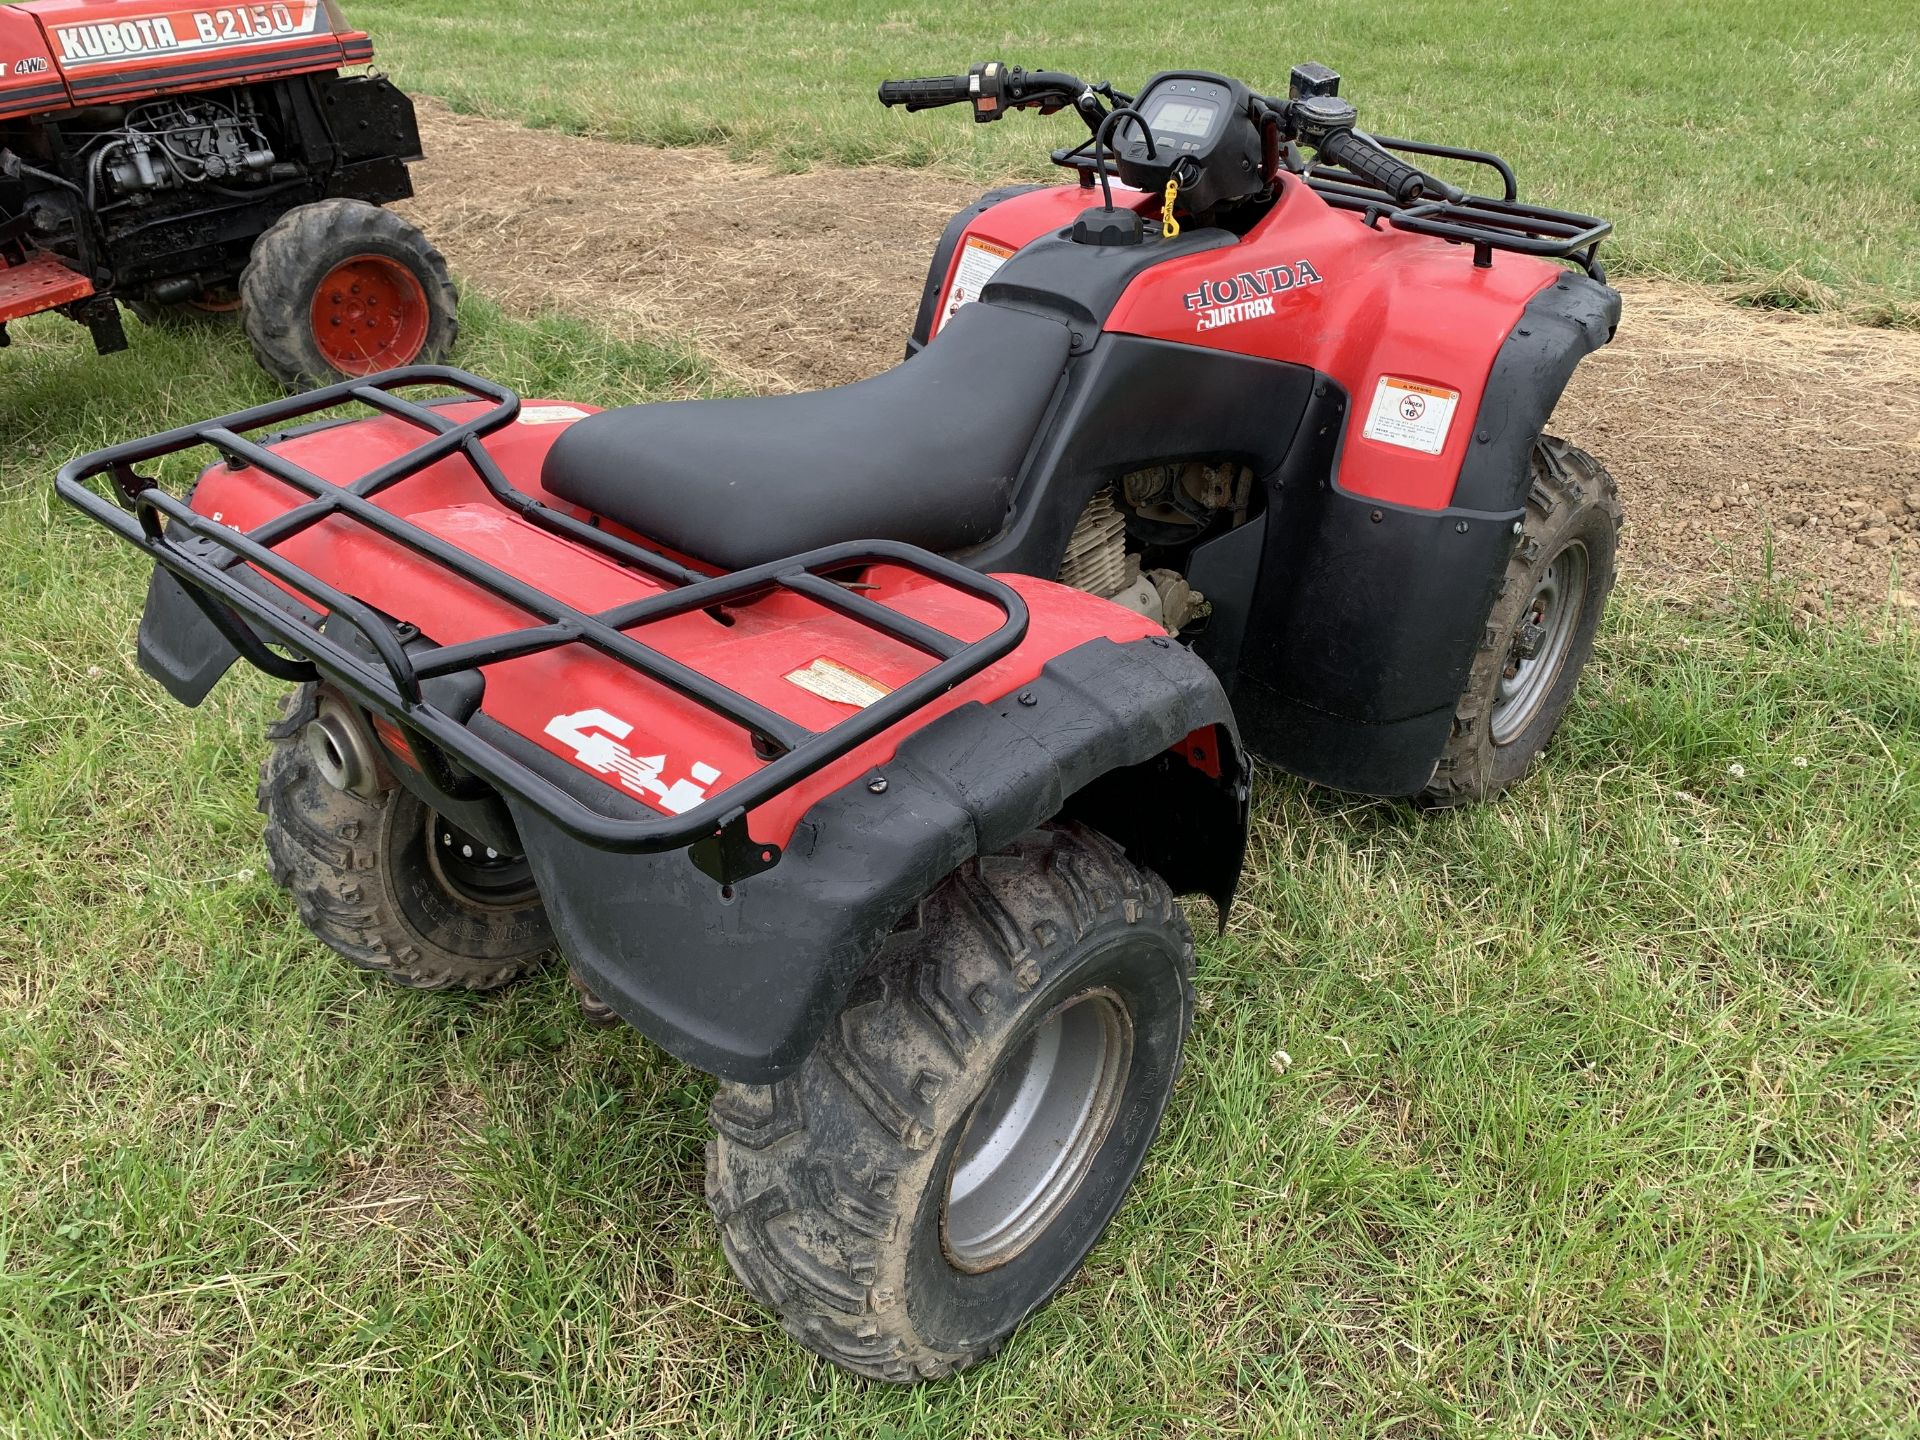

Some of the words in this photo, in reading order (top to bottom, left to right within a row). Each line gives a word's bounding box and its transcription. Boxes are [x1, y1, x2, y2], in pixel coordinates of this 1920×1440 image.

[55, 16, 179, 59] KUBOTA
[192, 3, 294, 44] B2150
[15, 57, 48, 75] 4WD
[1183, 258, 1323, 312] HONDA
[1409, 384, 1432, 394] WARNING
[1405, 400, 1422, 408] UNDER
[1405, 409, 1416, 417] 16
